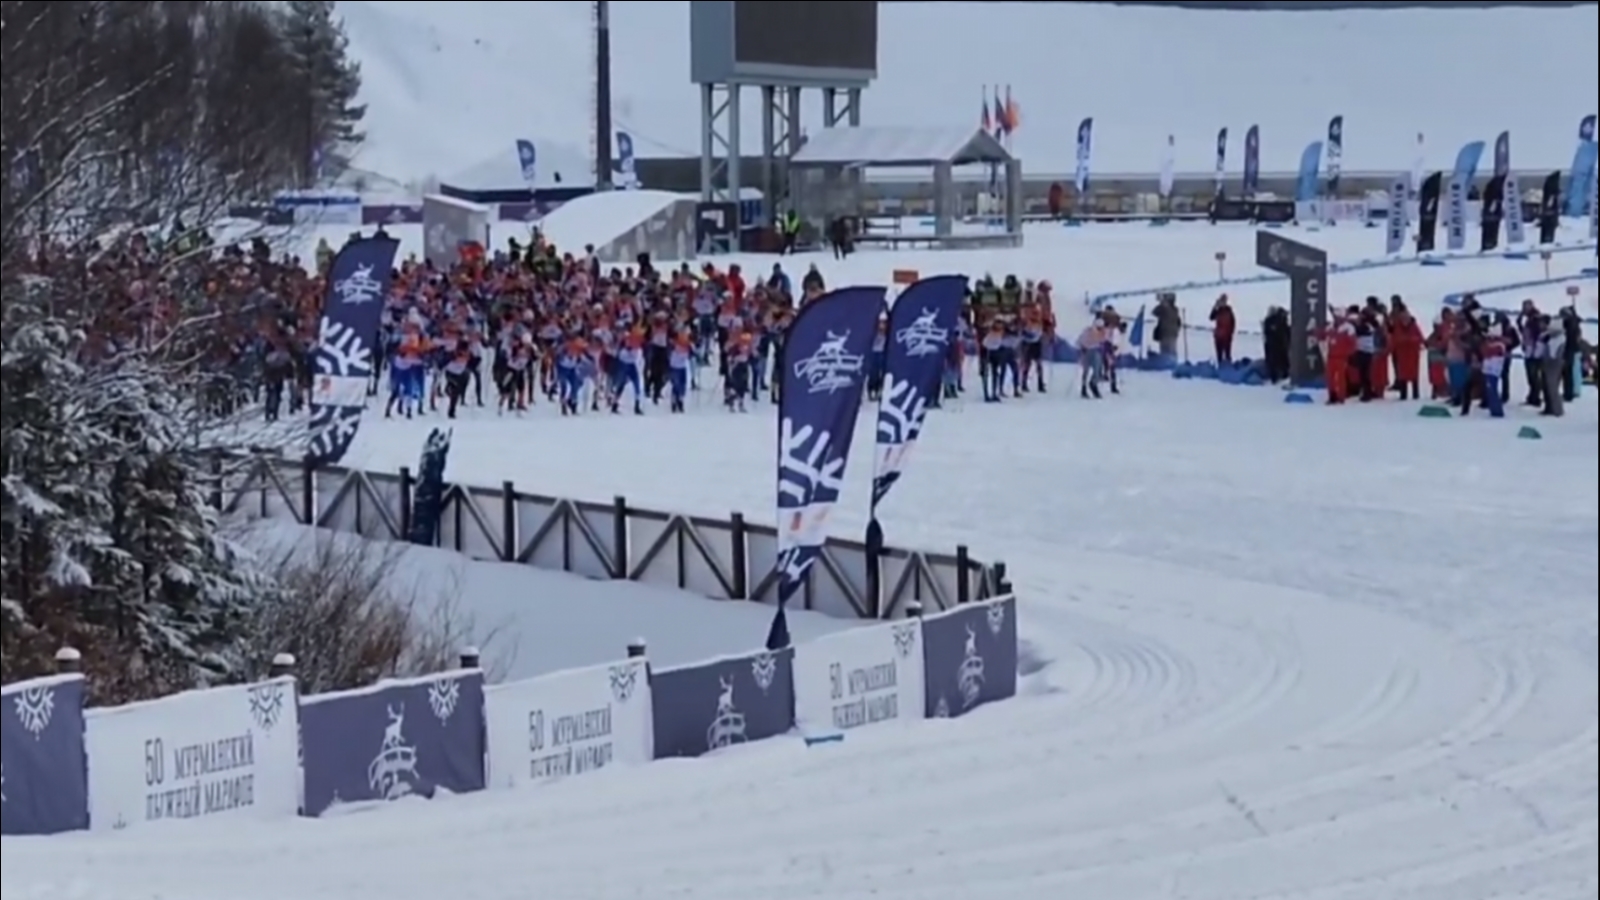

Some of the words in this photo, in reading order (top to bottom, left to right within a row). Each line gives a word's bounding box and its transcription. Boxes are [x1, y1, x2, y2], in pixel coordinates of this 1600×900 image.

[1306, 279, 1319, 370] СТАРТ
[829, 662, 842, 700] 50
[529, 709, 544, 752] 50
[551, 703, 612, 748] МУРМАНСКИЙ
[145, 737, 164, 786] 50
[174, 730, 255, 780] МУРМАНСКИЙ
[146, 780, 201, 820] ЛЫЖНЫЙ
[203, 774, 255, 815] МАРАФОН
